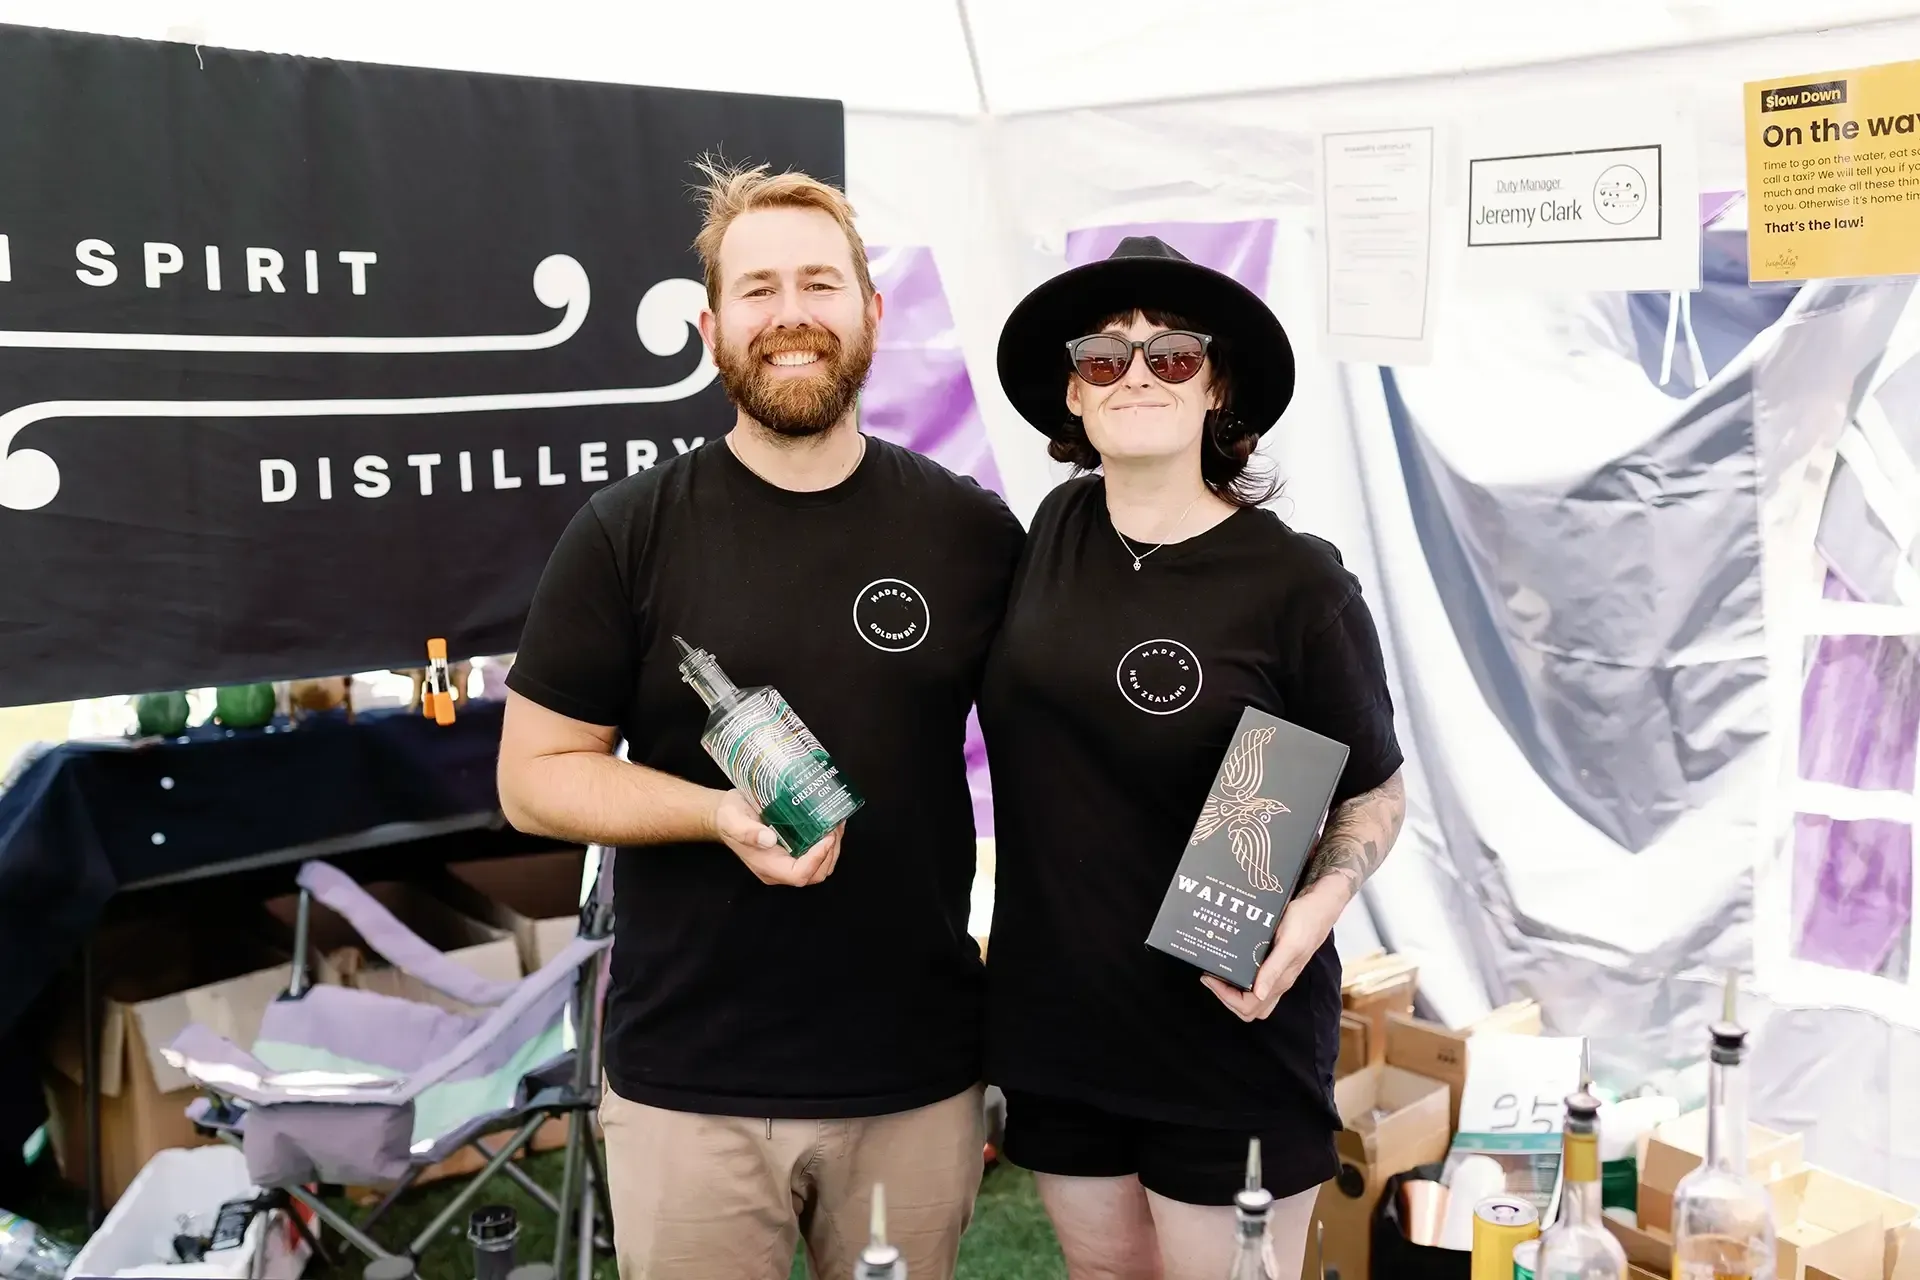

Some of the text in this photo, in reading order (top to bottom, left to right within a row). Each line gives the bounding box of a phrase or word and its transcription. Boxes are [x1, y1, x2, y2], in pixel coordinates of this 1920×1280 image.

[1766, 88, 1841, 108] Slow Down
[1763, 112, 1920, 148] On the wa
[1763, 161, 1787, 170] Time
[1789, 160, 1800, 168] to
[1802, 158, 1815, 169] go
[1817, 157, 1831, 165] on
[1833, 154, 1851, 163] the
[1853, 151, 1887, 162] water,
[1889, 148, 1908, 158] eat
[1762, 174, 1781, 184] call
[1783, 175, 1790, 183] a
[1792, 171, 1815, 182] taxi?
[1818, 170, 1834, 180] We
[1836, 167, 1854, 178] will
[1856, 165, 1872, 176] tell
[1875, 165, 1895, 177] you
[1898, 162, 1905, 172] if
[1496, 177, 1562, 194] Duty Manager
[1763, 188, 1792, 198] much
[1794, 185, 1815, 196] and
[1817, 183, 1847, 194] make
[1849, 181, 1862, 191] all
[1865, 179, 1895, 190] these
[1475, 198, 1583, 230] Jeremy Clark
[1764, 203, 1774, 212] to
[1776, 203, 1797, 214] you.
[1798, 197, 1850, 210] Otherwise
[1852, 195, 1868, 205] it's
[1870, 193, 1903, 204] home
[1764, 215, 1864, 234] That's the law!
[75, 238, 379, 296] SPIRIT
[869, 588, 913, 603] MADE OF
[1141, 648, 1190, 671] MADE OF
[1129, 669, 1187, 703] NEW ZEALAND
[788, 777, 804, 793] NEW
[803, 759, 828, 780] ZEALAND
[791, 765, 840, 806] GREENSTONE
[817, 783, 832, 798] GIN
[1178, 874, 1275, 928] WAITUI
[1192, 909, 1241, 936] WHISKEY
[1222, 915, 1238, 926] MALT
